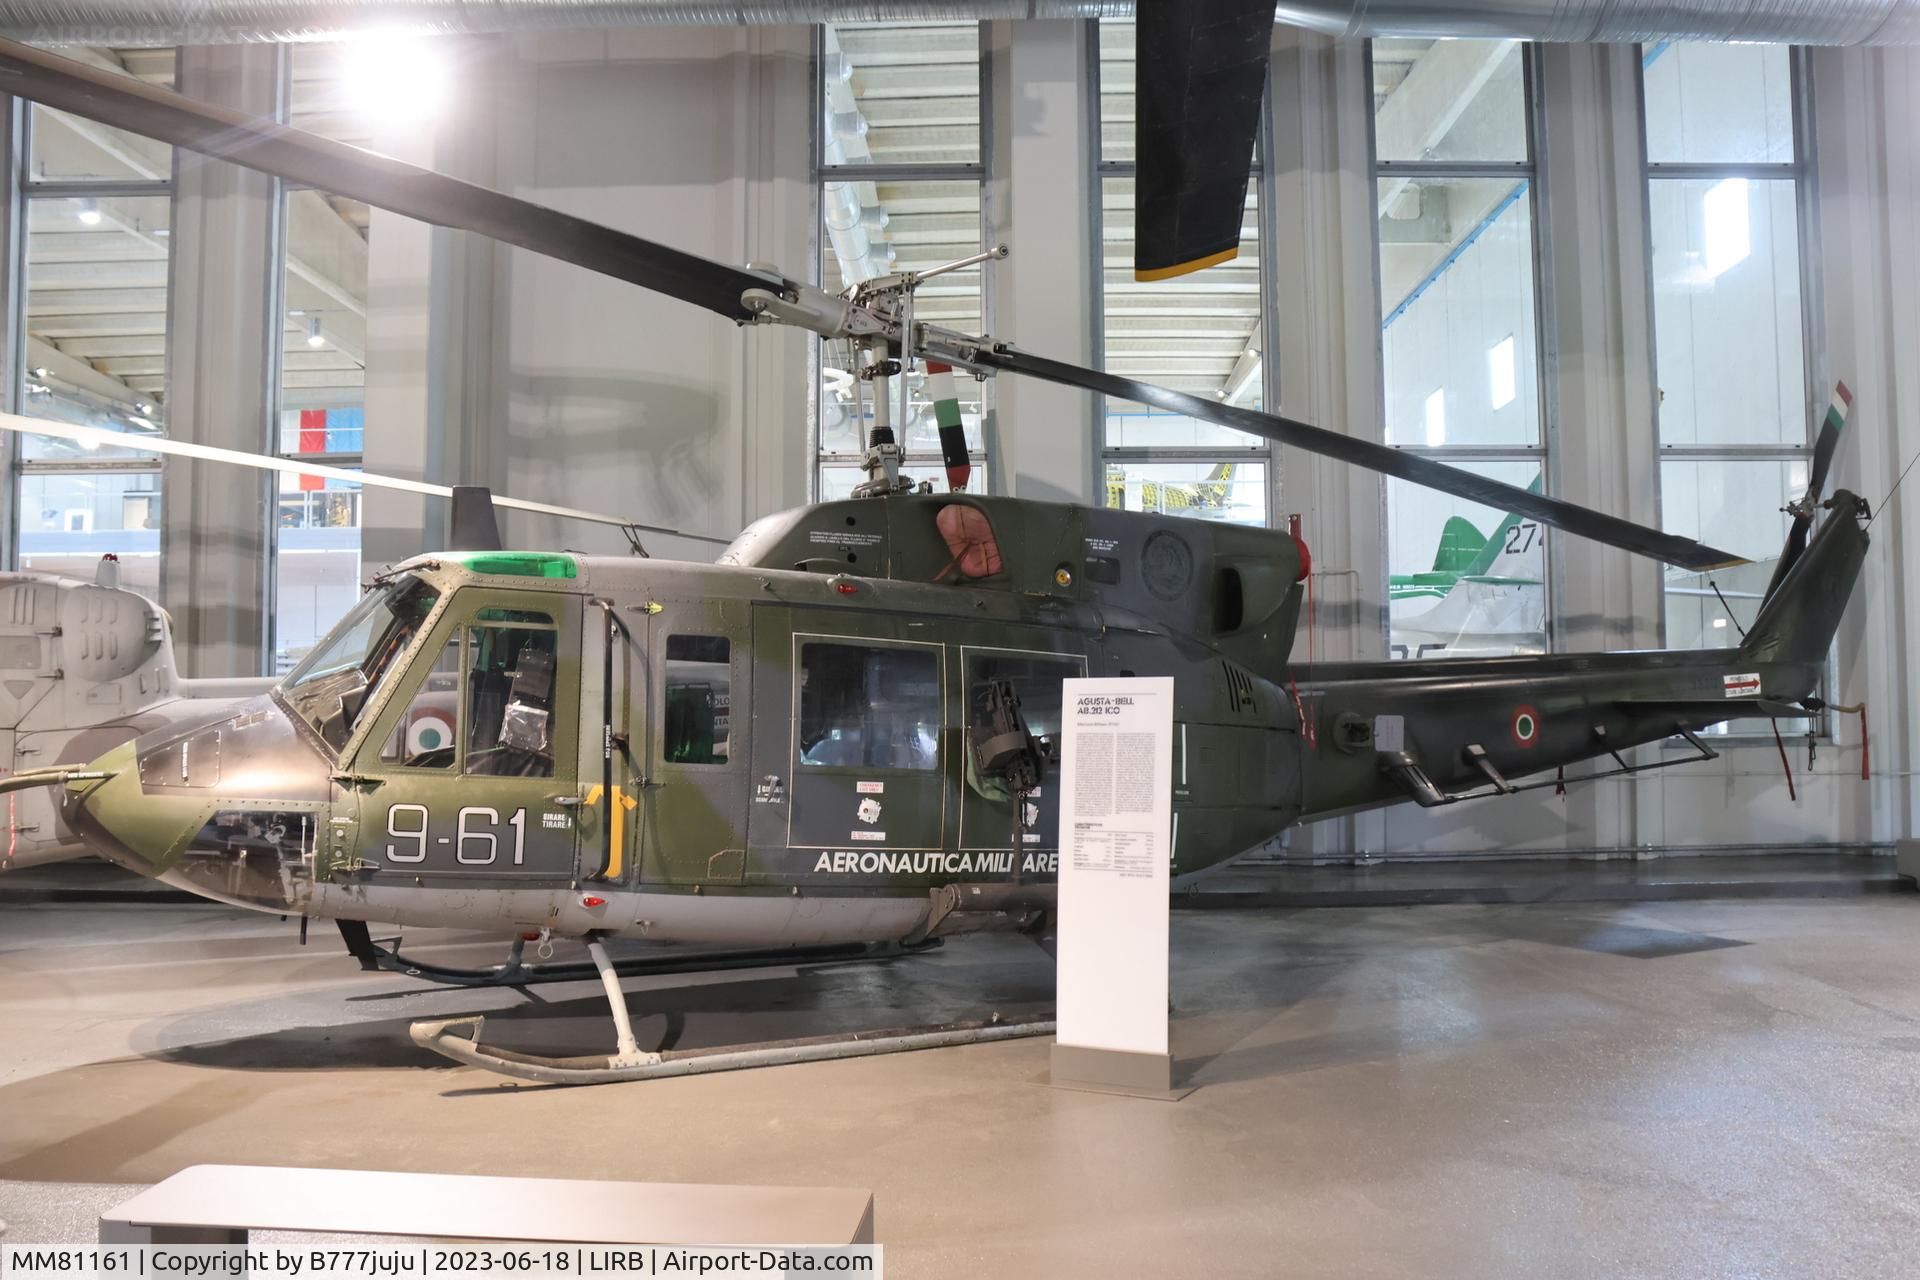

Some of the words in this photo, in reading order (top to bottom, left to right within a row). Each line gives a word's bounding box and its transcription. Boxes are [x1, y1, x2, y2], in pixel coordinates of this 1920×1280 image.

[1505, 523, 1543, 554] 27
[386, 803, 527, 865] 9-61
[542, 821, 567, 829] TIRARE
[813, 851, 974, 873] AERONAUTICA
[974, 852, 1058, 873] MILIARE
